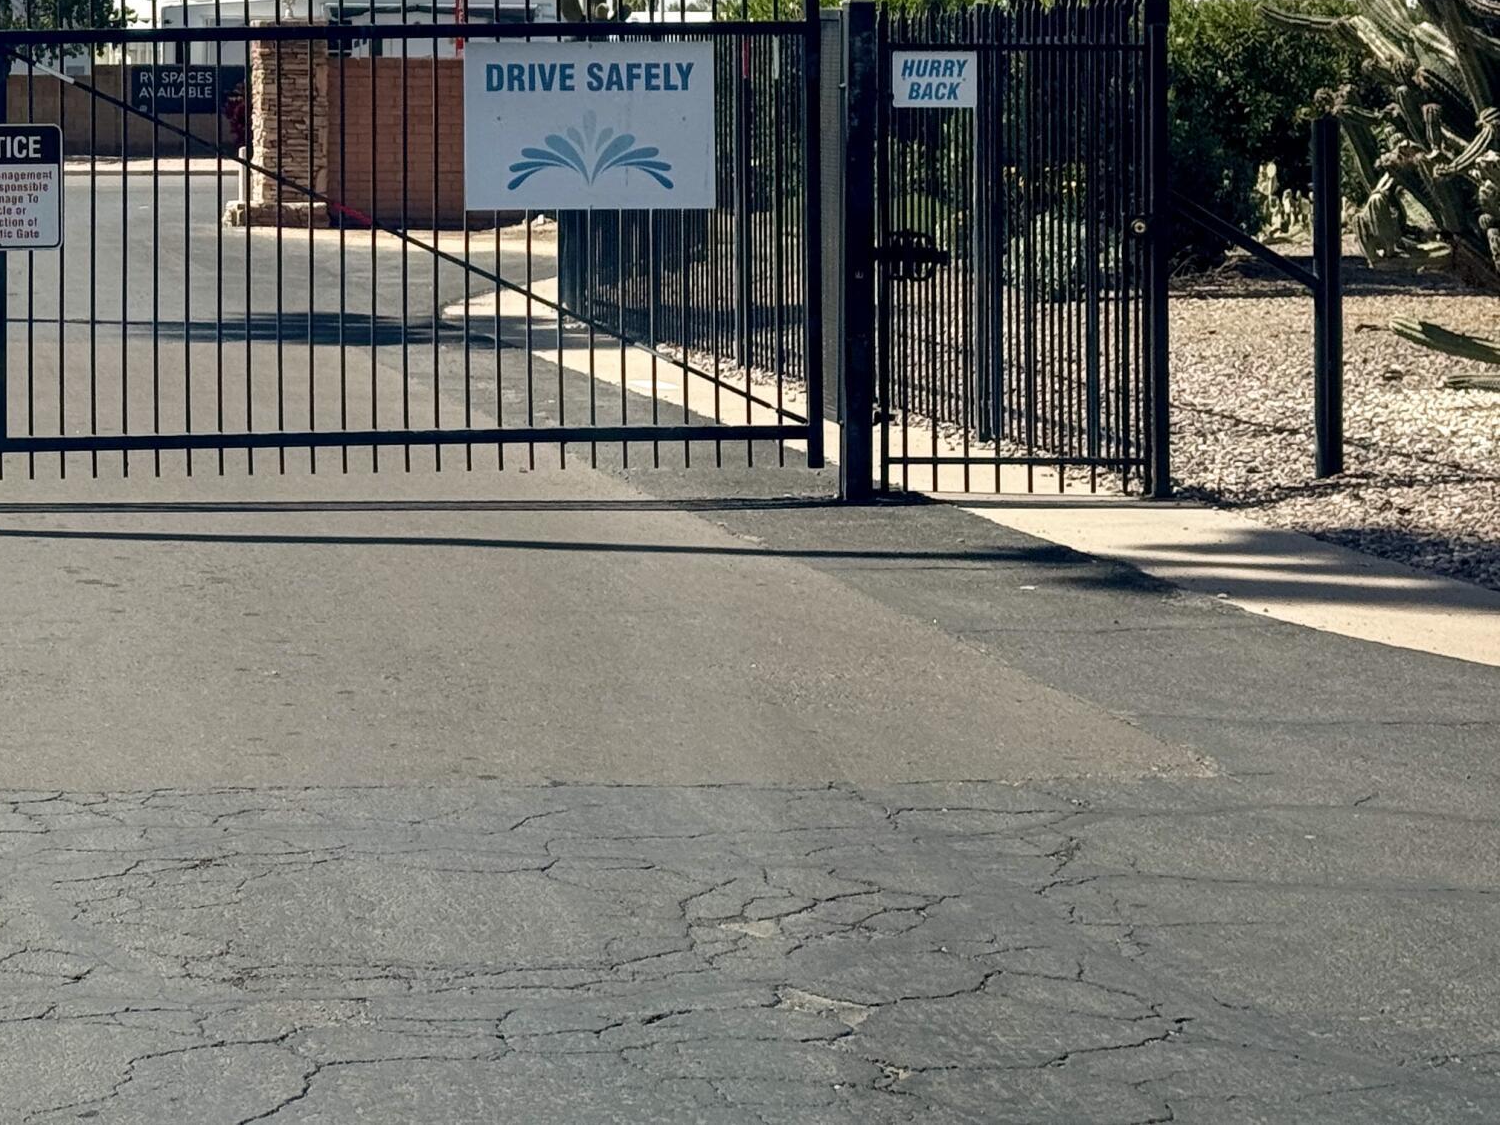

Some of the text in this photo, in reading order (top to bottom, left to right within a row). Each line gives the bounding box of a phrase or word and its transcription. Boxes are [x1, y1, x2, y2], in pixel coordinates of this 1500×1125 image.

[901, 59, 968, 77] HURRY
[162, 71, 213, 84] SPACES
[485, 62, 694, 92] DRIVE SAFELY
[908, 82, 961, 100] BACK
[27, 193, 39, 204] To
[15, 207, 27, 216] or
[27, 217, 38, 228] of
[16, 229, 40, 239] Gate
